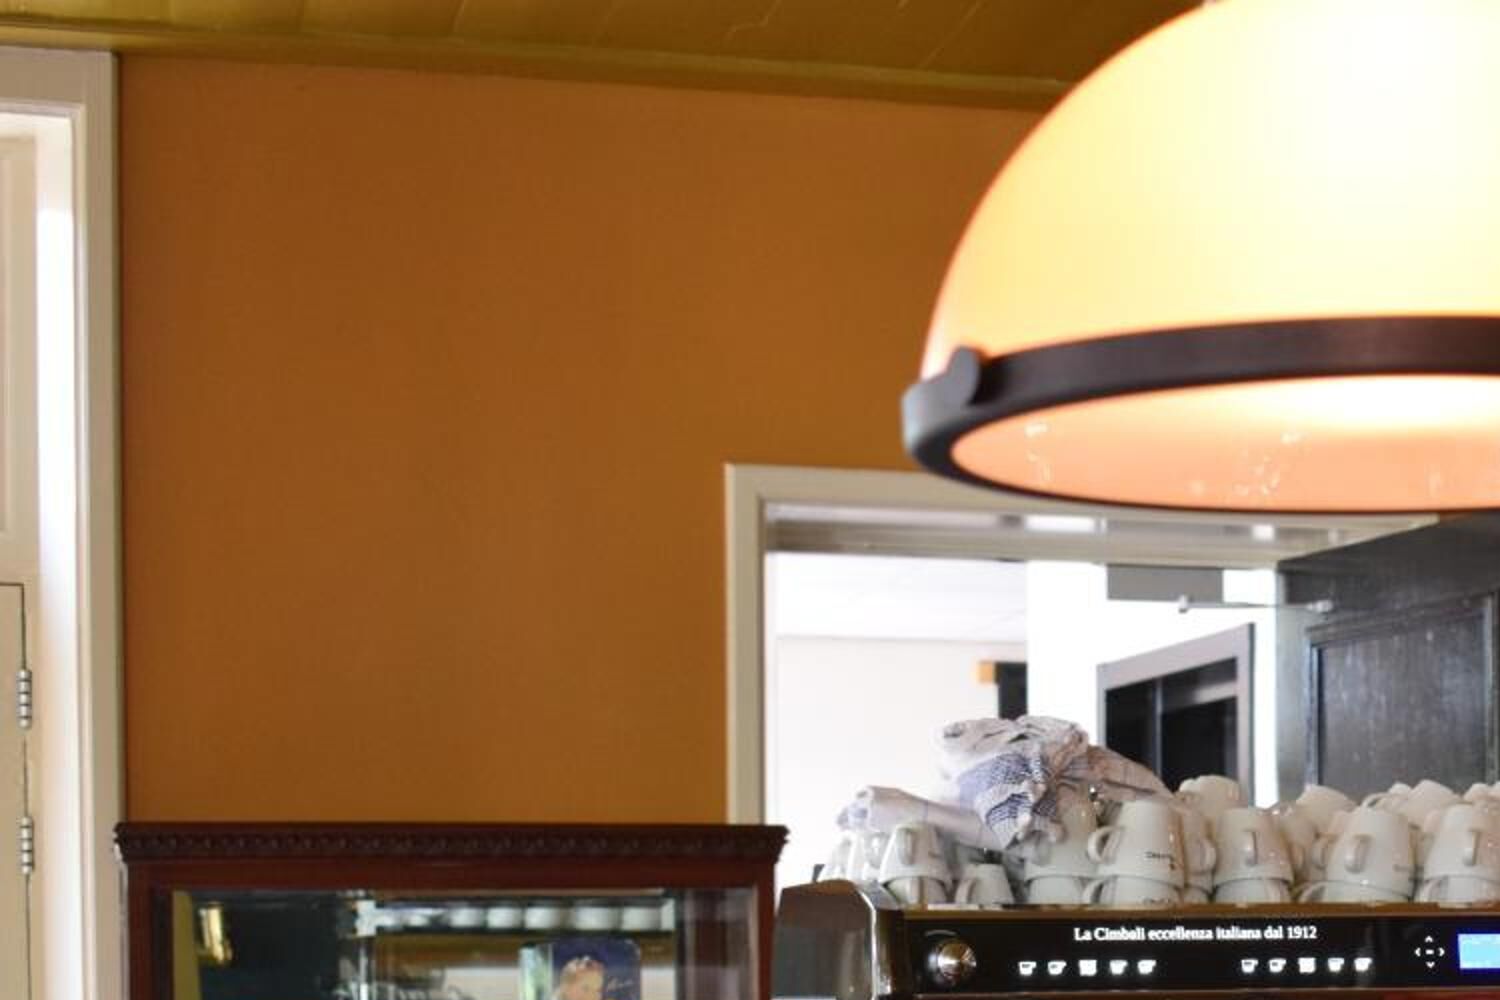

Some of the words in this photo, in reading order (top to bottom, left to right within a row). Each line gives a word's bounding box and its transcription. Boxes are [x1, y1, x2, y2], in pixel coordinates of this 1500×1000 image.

[1074, 927, 1092, 941] La
[1094, 926, 1146, 941] Cimbali
[1148, 926, 1213, 940] eccellenza
[1216, 925, 1262, 940] italiana
[1264, 925, 1283, 939] dal
[1287, 925, 1317, 939] 1912
